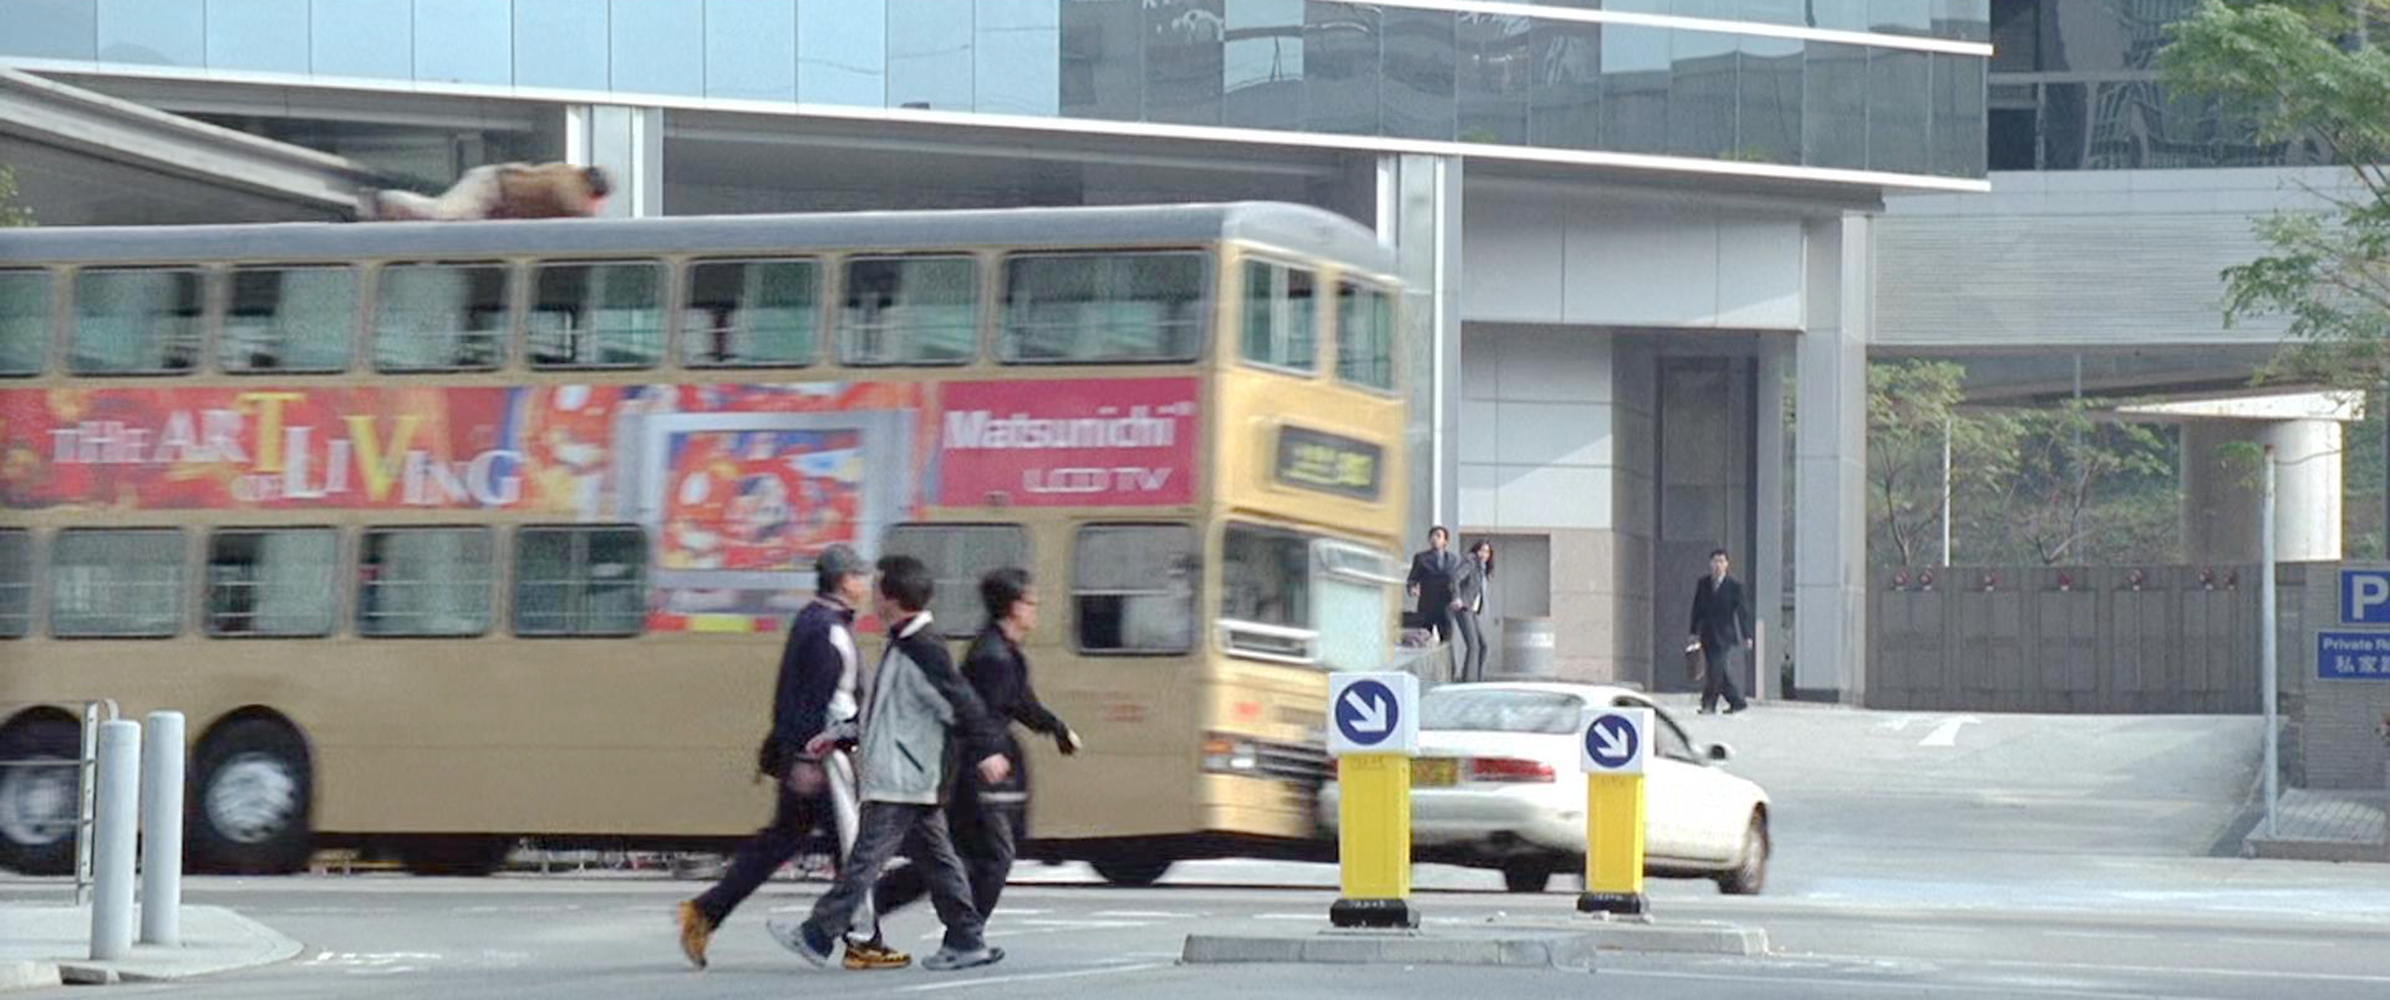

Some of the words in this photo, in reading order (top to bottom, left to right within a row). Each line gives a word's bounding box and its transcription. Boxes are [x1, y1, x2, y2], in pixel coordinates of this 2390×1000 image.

[48, 420, 152, 464] THE
[152, 391, 306, 473] ART
[943, 404, 1176, 448] Matsunichi
[283, 414, 524, 504] LIVING
[1110, 467, 1173, 492] TV
[2352, 575, 2389, 620] P
[2323, 638, 2373, 650] Private
